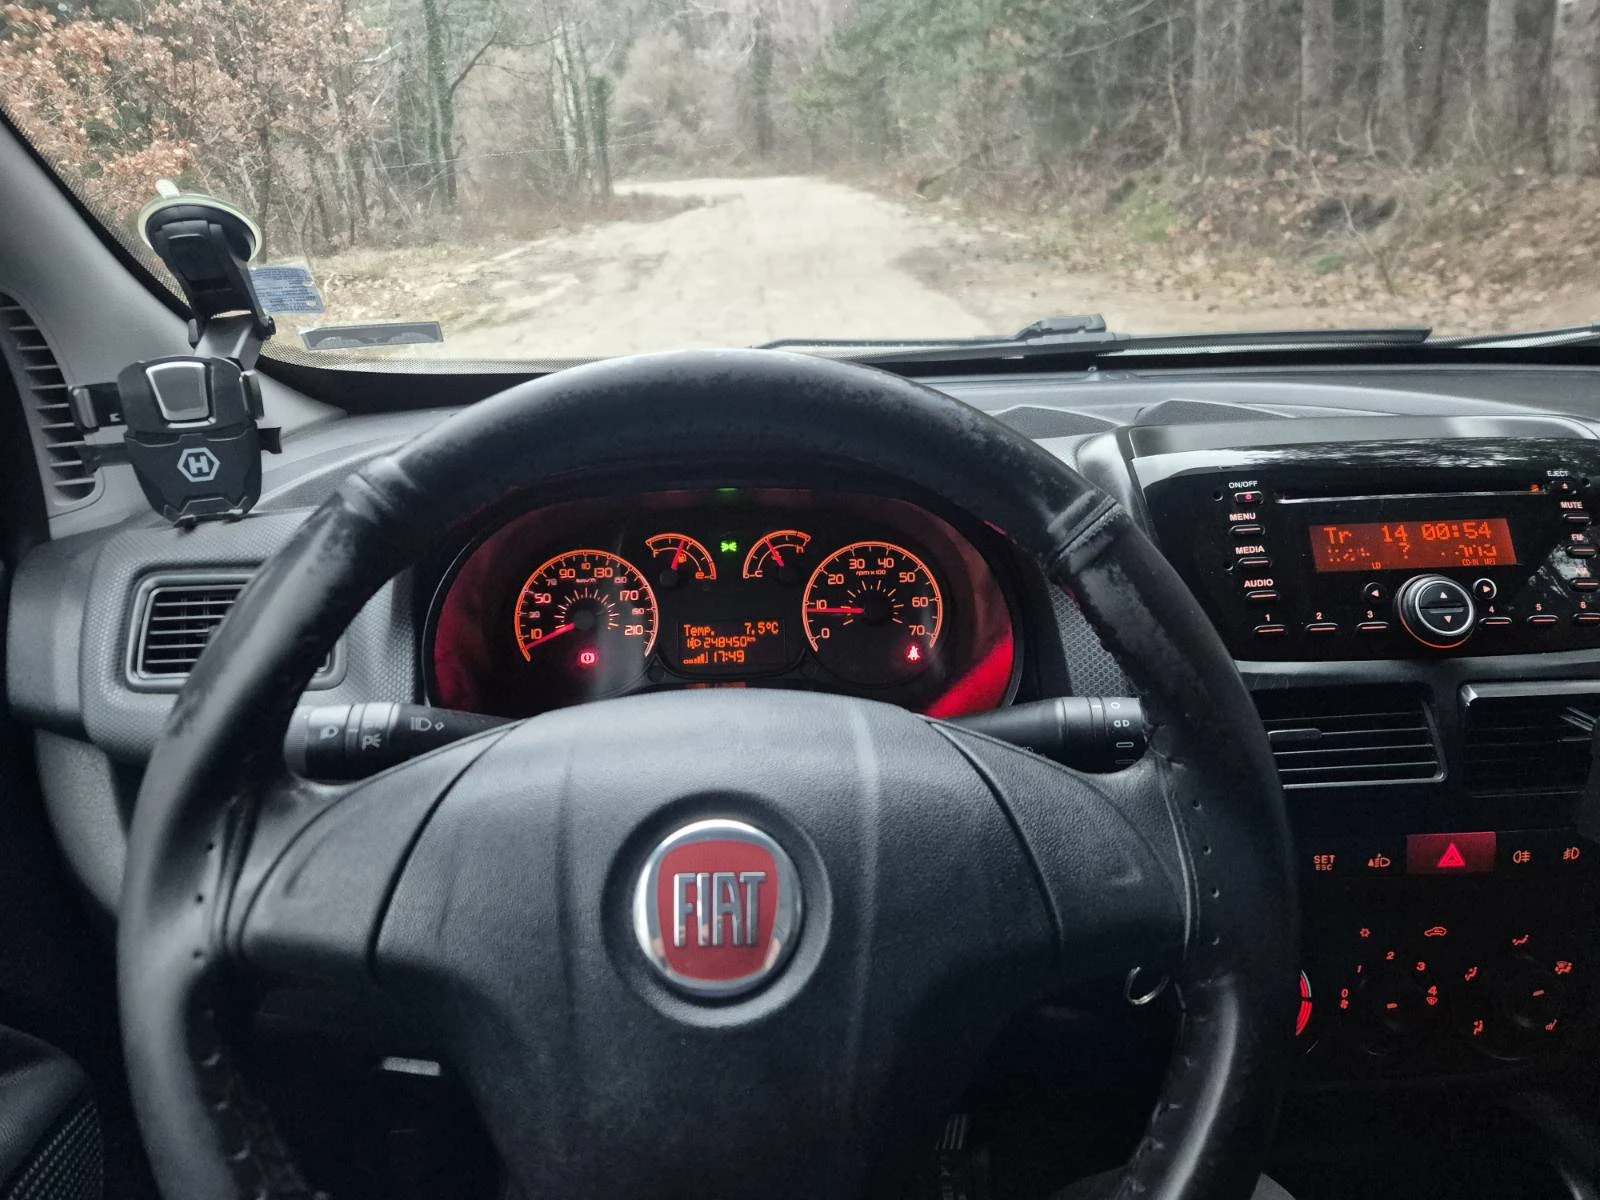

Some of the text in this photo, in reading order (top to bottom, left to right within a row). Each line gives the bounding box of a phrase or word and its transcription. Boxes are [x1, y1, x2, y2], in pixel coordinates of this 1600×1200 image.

[187, 455, 211, 476] H
[1228, 480, 1259, 489] ON/OFF
[1560, 501, 1583, 509] MUTE
[1229, 512, 1256, 521] MENU
[1323, 521, 1492, 544] Tr 14 00:54
[652, 550, 659, 558] F
[1235, 545, 1265, 555] MEDIA
[849, 558, 865, 569] 30
[877, 558, 894, 568] 40
[559, 568, 576, 579] 90
[594, 567, 613, 578] 130
[899, 572, 915, 583] 50
[828, 574, 844, 584] 20
[1244, 578, 1274, 588] AUDIO
[534, 593, 551, 604] 50
[620, 590, 639, 601] 170
[816, 600, 827, 610] 10
[912, 597, 929, 608] 60
[1536, 603, 1542, 611] 5
[1580, 601, 1587, 609] 6
[1488, 604, 1495, 613] 4
[1316, 612, 1322, 620] 2
[1366, 610, 1374, 619] 3
[530, 628, 542, 639] 10
[624, 625, 643, 635] 210
[684, 624, 715, 636] Temp.
[821, 628, 830, 638] 0
[909, 625, 925, 636] 70
[713, 650, 745, 662] 17:49
[1313, 854, 1336, 864] SET
[673, 871, 766, 947] FIAT
[1386, 951, 1395, 960] 2
[1356, 964, 1362, 973] 1
[1416, 962, 1426, 971] 3
[1341, 988, 1349, 998] 0
[1428, 986, 1438, 995] 4
